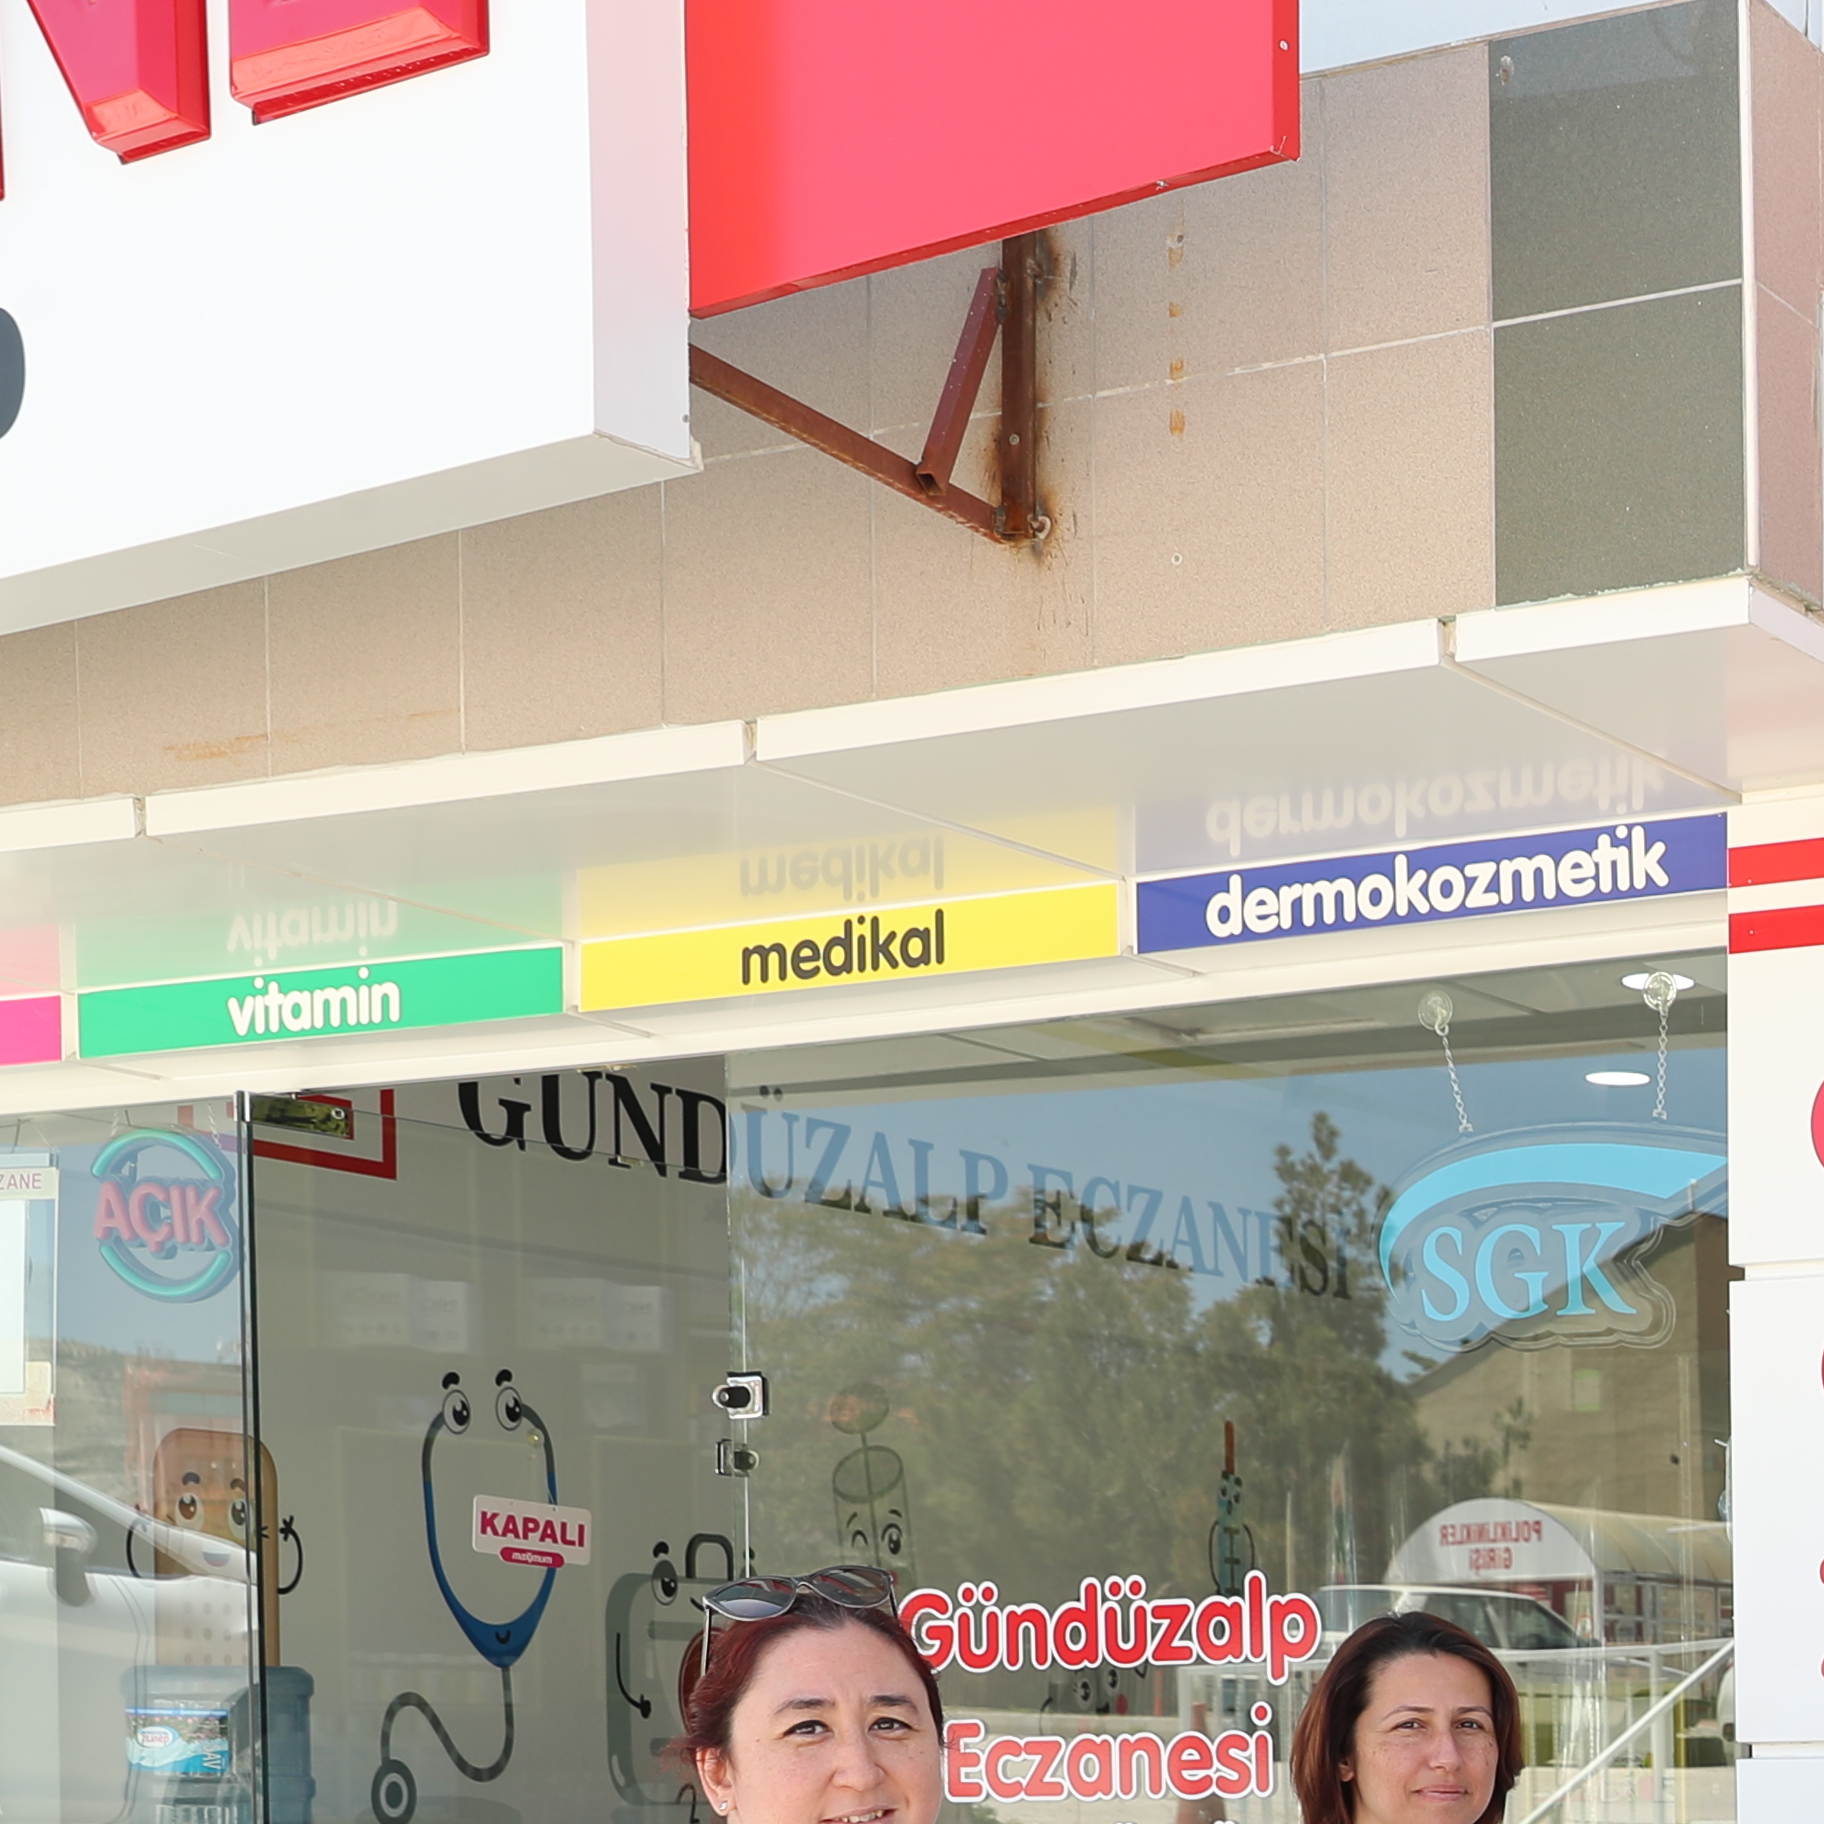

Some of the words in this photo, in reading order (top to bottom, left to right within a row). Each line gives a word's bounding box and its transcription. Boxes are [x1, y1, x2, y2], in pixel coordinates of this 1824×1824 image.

[1205, 825, 1670, 939] dermokozmetik
[742, 909, 944, 986] medikal
[227, 966, 401, 1036] vitamin
[94, 1180, 229, 1252] AÇIK
[1421, 1222, 1637, 1321] SGK
[480, 1510, 585, 1547] KAPALI
[899, 1570, 1321, 1686] Gündüzalp
[943, 1700, 1276, 1802] Eczanesi
